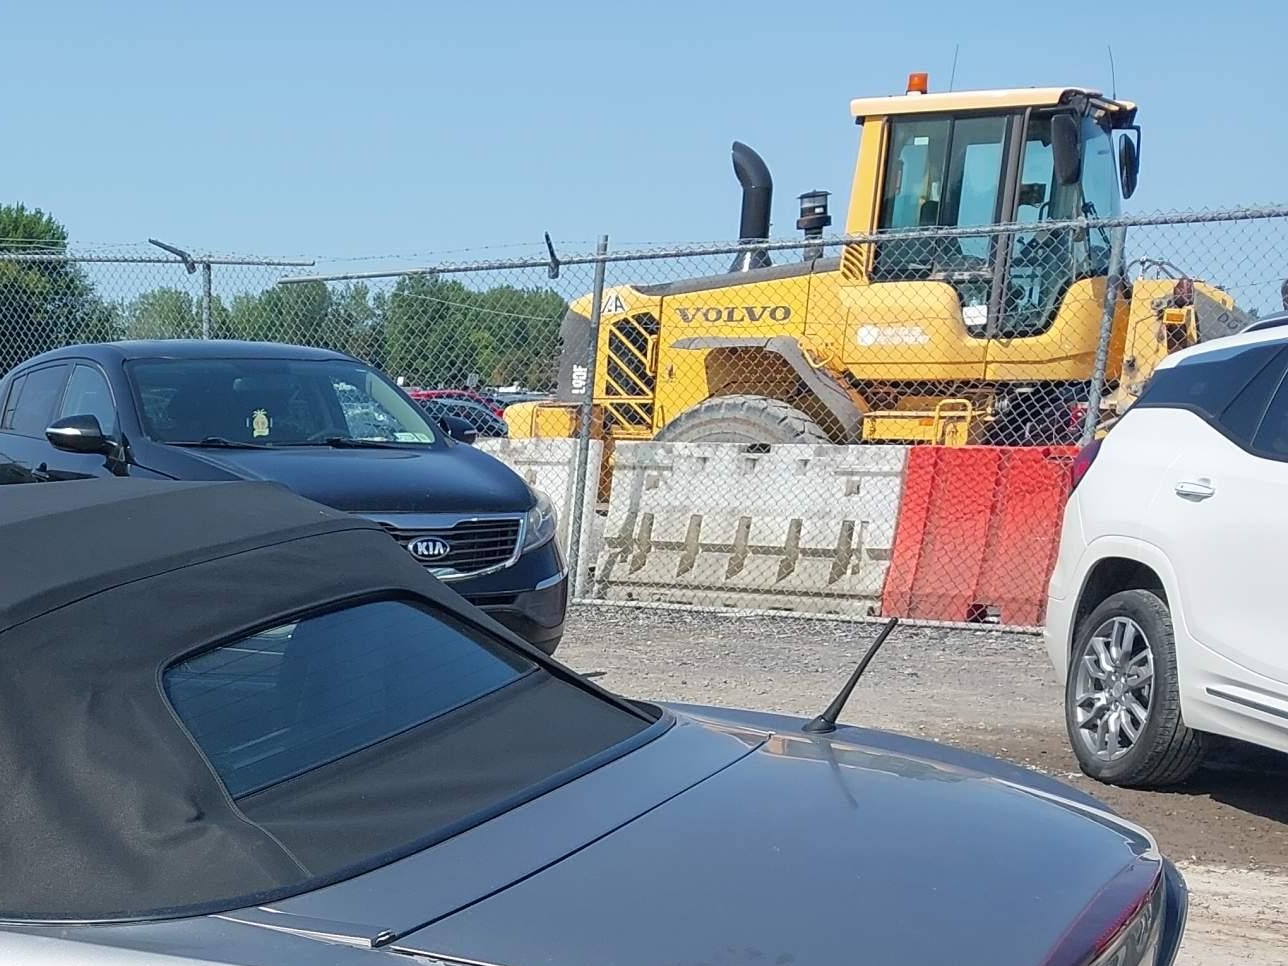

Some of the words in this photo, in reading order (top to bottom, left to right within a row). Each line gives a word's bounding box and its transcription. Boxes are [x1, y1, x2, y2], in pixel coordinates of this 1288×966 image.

[674, 305, 792, 323] VOLVO
[572, 364, 588, 395] L90F
[417, 541, 444, 555] KIA
